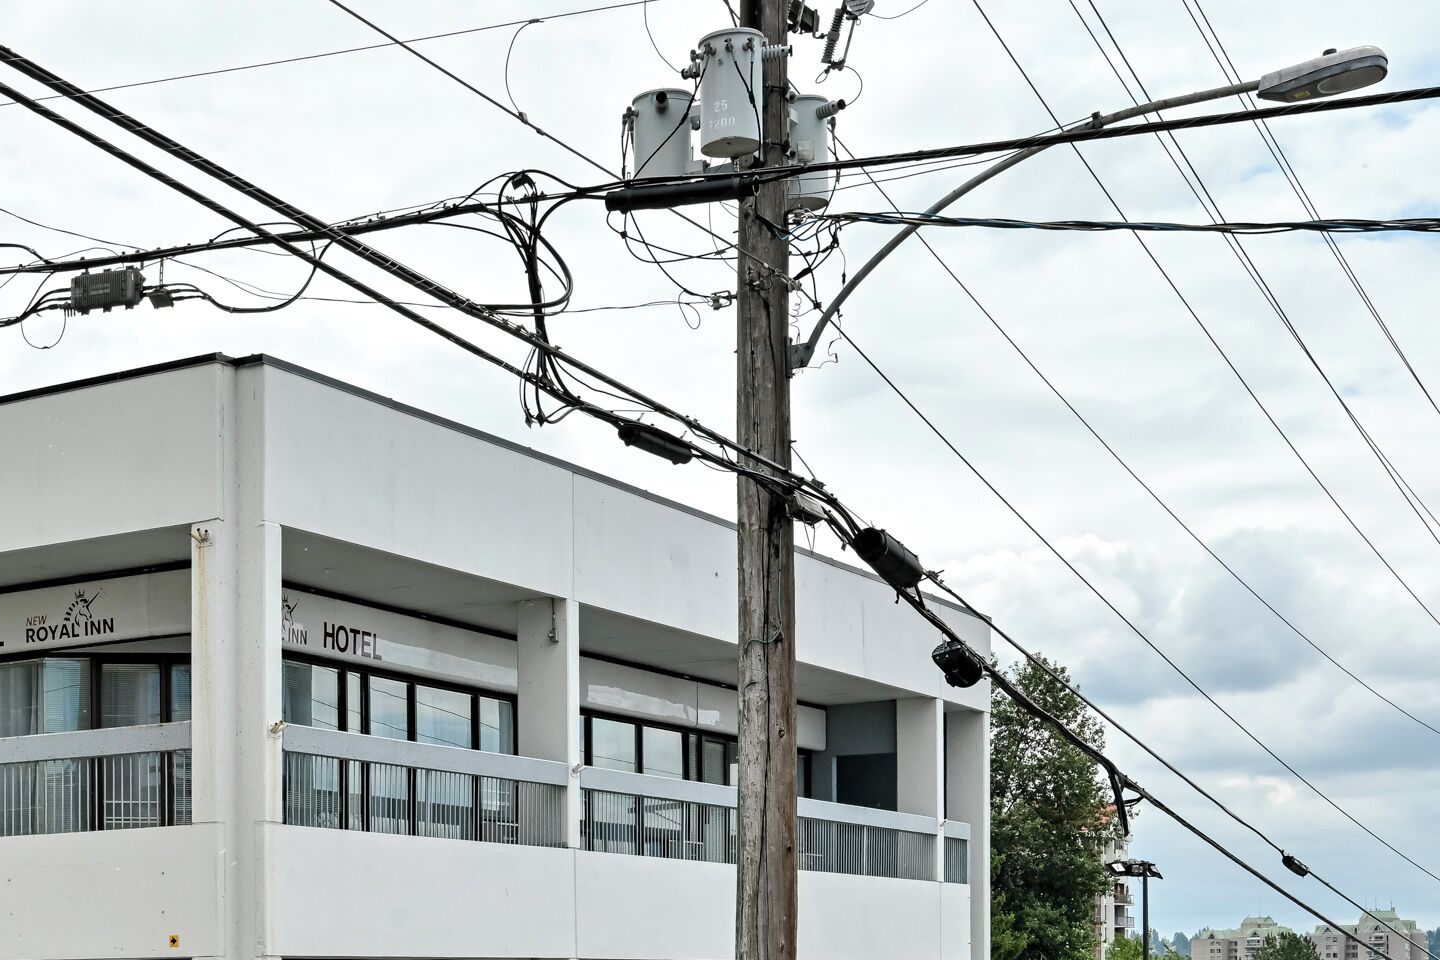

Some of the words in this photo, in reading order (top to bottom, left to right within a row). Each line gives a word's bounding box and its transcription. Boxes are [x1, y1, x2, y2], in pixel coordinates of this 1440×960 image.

[713, 99, 728, 113] 25
[25, 614, 47, 627] NEW
[25, 622, 80, 644] ROYAL
[84, 617, 114, 637] INN
[288, 627, 307, 646] INN
[323, 621, 383, 661] HOTEL
